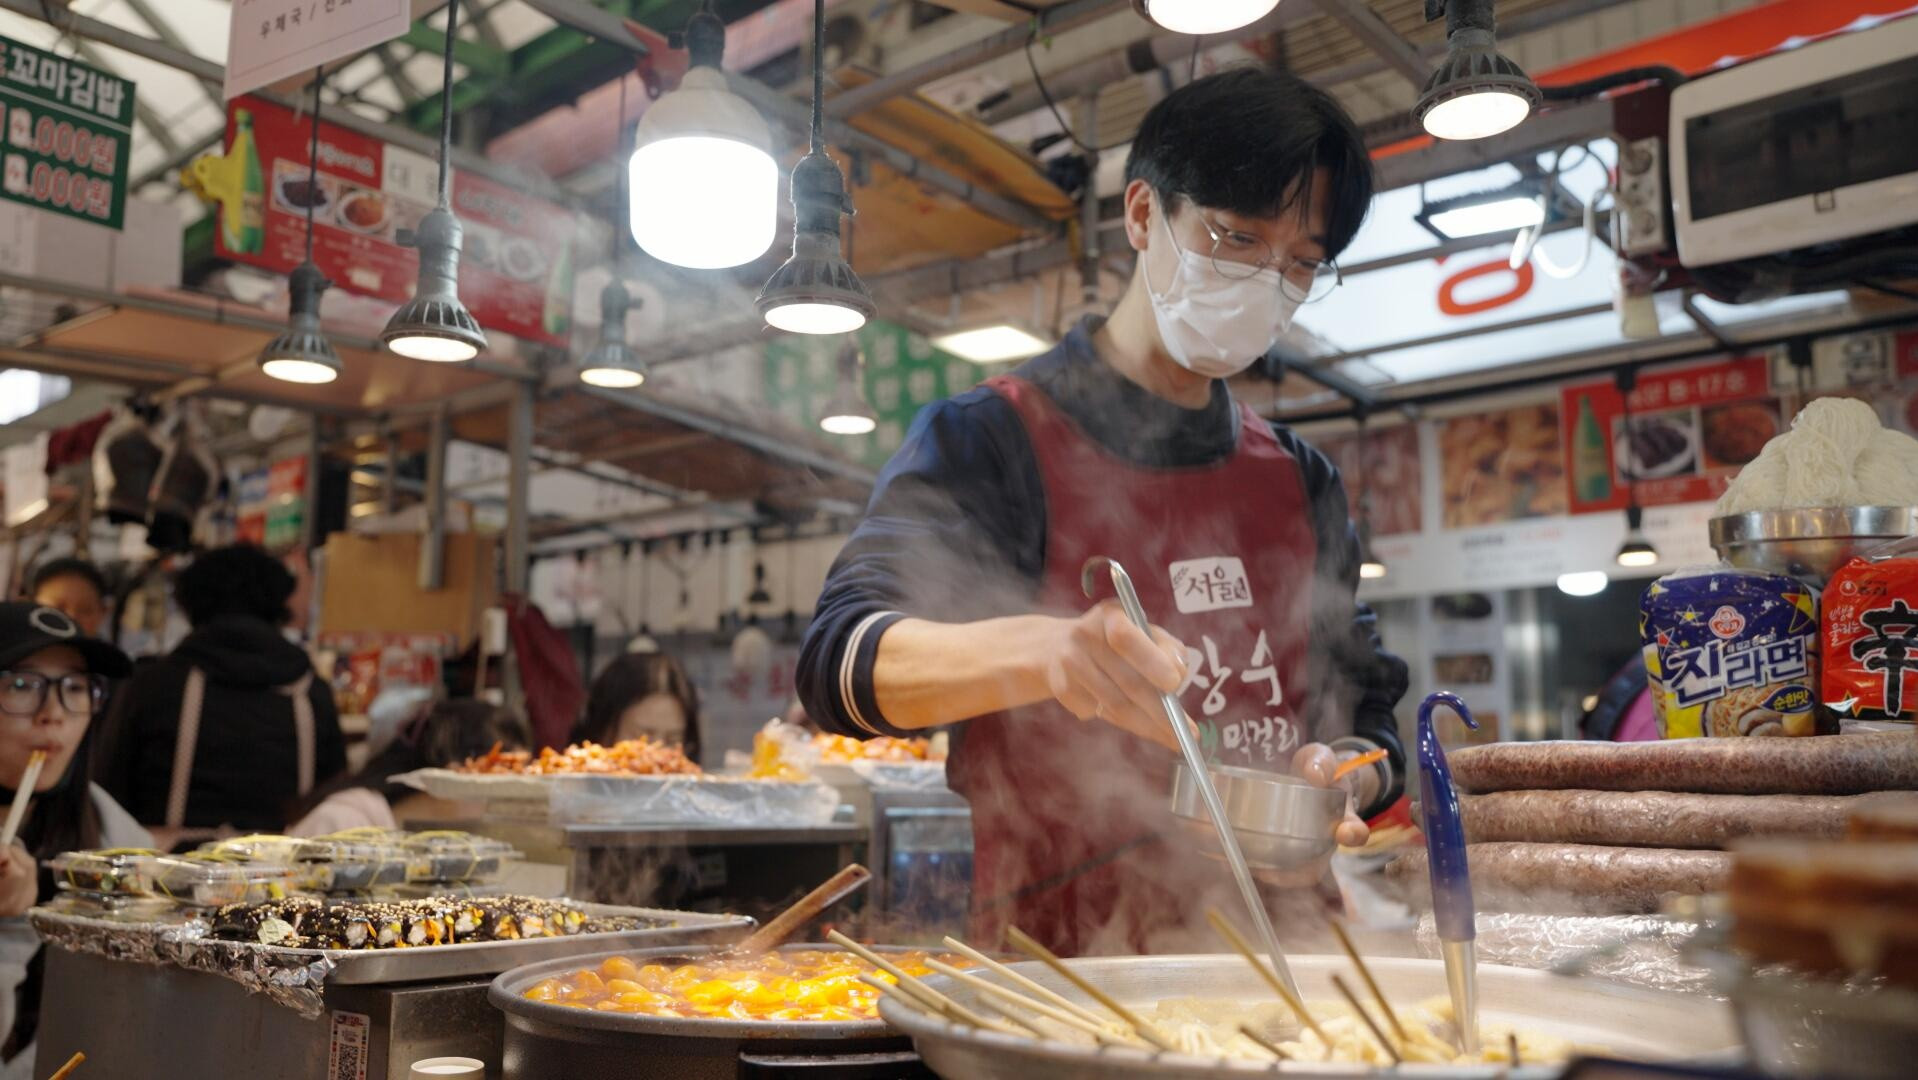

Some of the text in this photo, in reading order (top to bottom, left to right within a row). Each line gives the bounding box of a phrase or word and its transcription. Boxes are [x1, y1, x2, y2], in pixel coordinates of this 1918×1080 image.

[8, 47, 125, 119] 꼬마김밥
[1184, 564, 1233, 604] 서울
[1175, 628, 1283, 716] 장수
[1665, 634, 1808, 709] 진라면
[1772, 688, 1810, 712] 순한맛
[1222, 716, 1300, 762] 막걸리
